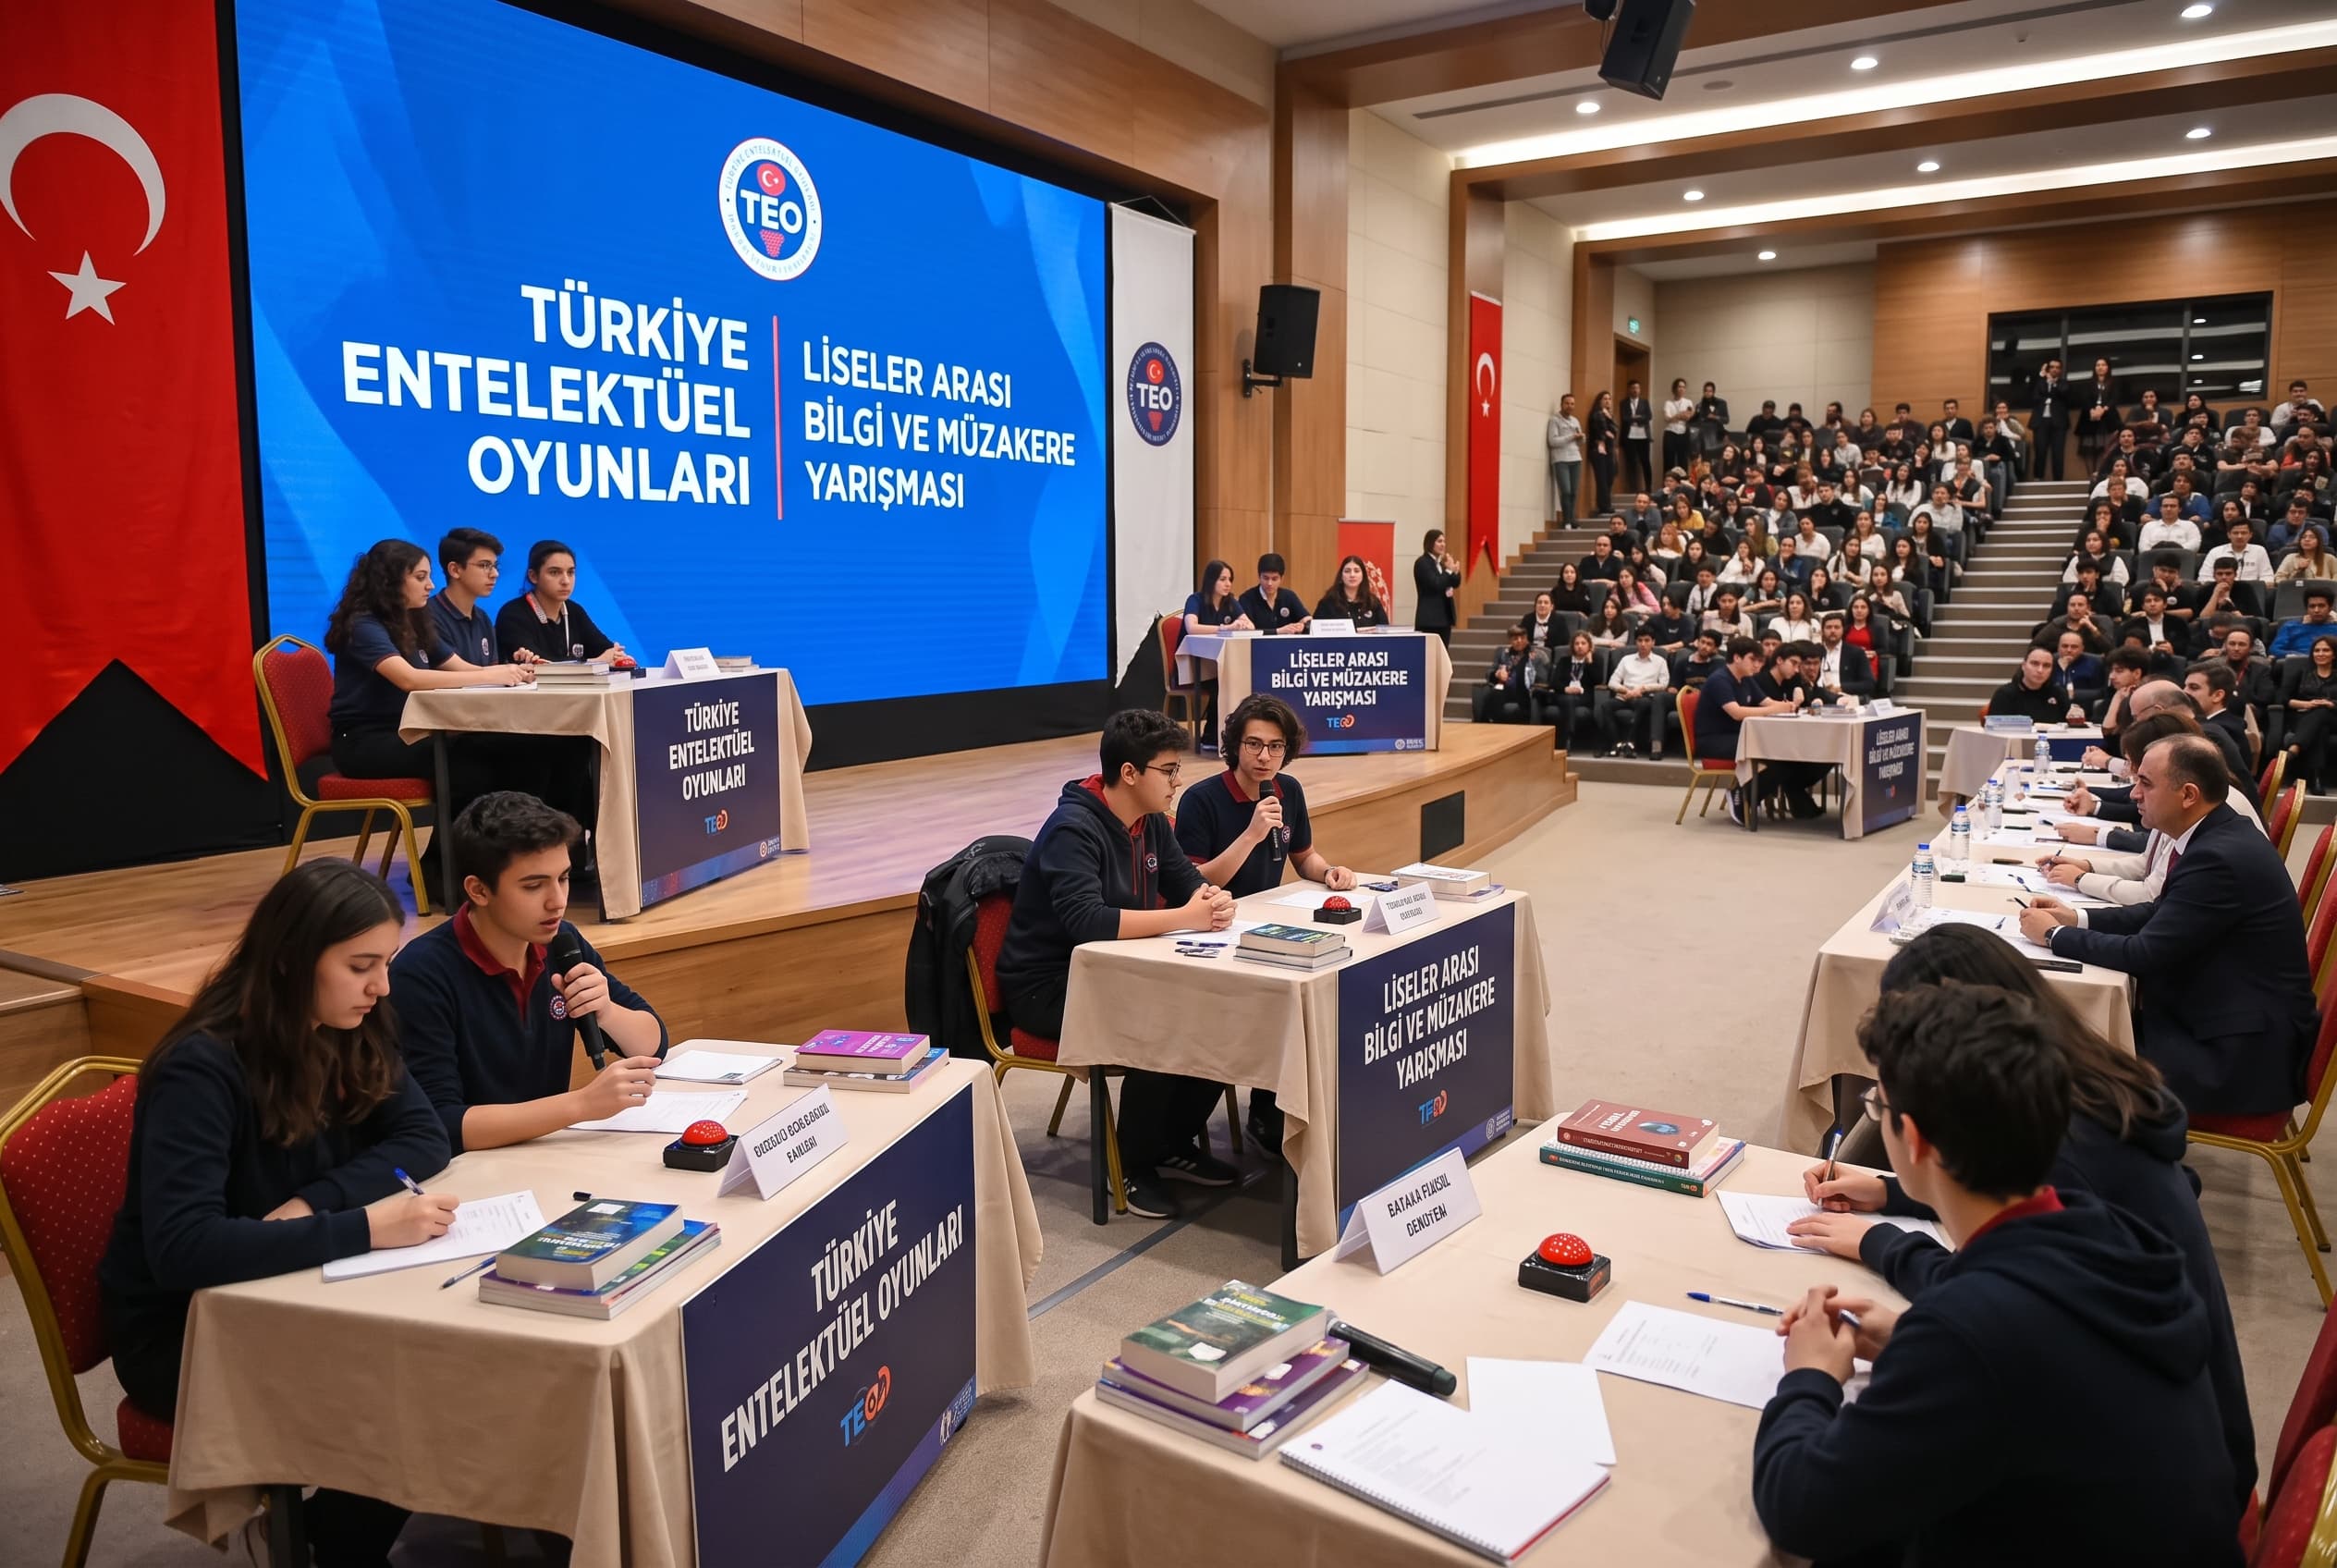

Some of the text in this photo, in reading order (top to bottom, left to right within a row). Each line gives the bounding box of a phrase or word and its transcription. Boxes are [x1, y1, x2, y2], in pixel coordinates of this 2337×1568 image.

[740, 189, 803, 234] TEO
[520, 278, 749, 371] TÜRKİYE
[342, 340, 752, 439] ENTELEKTÜEL
[803, 336, 1011, 409] LİSELER ARASI
[1136, 382, 1173, 410] TEO
[803, 396, 884, 448] BİLGİ
[891, 411, 930, 452] VE
[937, 412, 1076, 466] MÜZAKERE
[468, 435, 751, 506] OYUNLARI
[804, 460, 964, 511] YARIŞMASI
[1271, 668, 1408, 688] BİLGİ VE MÜZAKERE
[1291, 649, 1389, 668] LİSELER ARASI
[684, 698, 740, 733] TÜRKİYE
[1303, 690, 1377, 709] YARIŞMASI
[669, 729, 755, 770] ENTELEKTÜEL
[682, 763, 746, 801] OYUNLARI
[1384, 944, 1479, 1014] LİSELER ARASI
[1364, 976, 1495, 1066] BİLGİ VE MÜZAKERE
[1396, 1028, 1467, 1090] YARIŞMASI
[811, 1198, 899, 1313] TÜRKİYE
[720, 1204, 964, 1473] ENTELEKTÜEL OYUNLARI
